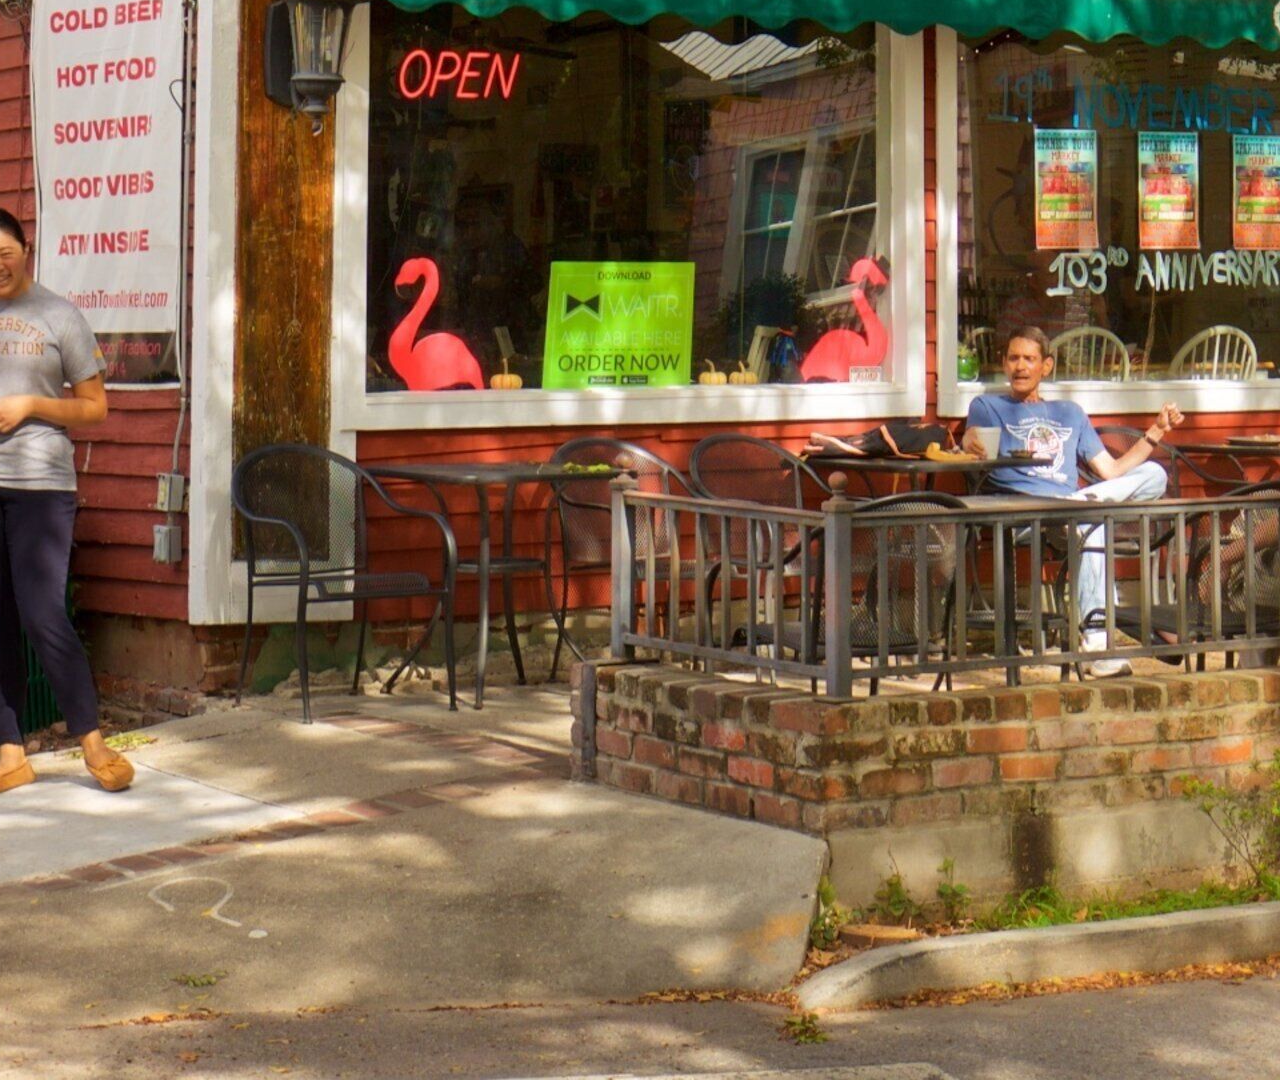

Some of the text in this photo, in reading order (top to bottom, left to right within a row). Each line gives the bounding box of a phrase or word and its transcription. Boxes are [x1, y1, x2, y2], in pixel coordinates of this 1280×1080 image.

[50, 7, 108, 34] COLD
[56, 56, 156, 88] HOT FOOD
[400, 49, 520, 99] OPEN
[1072, 76, 1275, 136] NOVEMBER
[54, 114, 152, 145] SOUVENIR
[54, 170, 155, 200] GOOD VIBS
[93, 228, 150, 255] INSIDE
[597, 271, 652, 281] DOWNLOAD
[560, 330, 682, 347] AVAILABLE HERE
[558, 352, 681, 372] ORDER NOW
